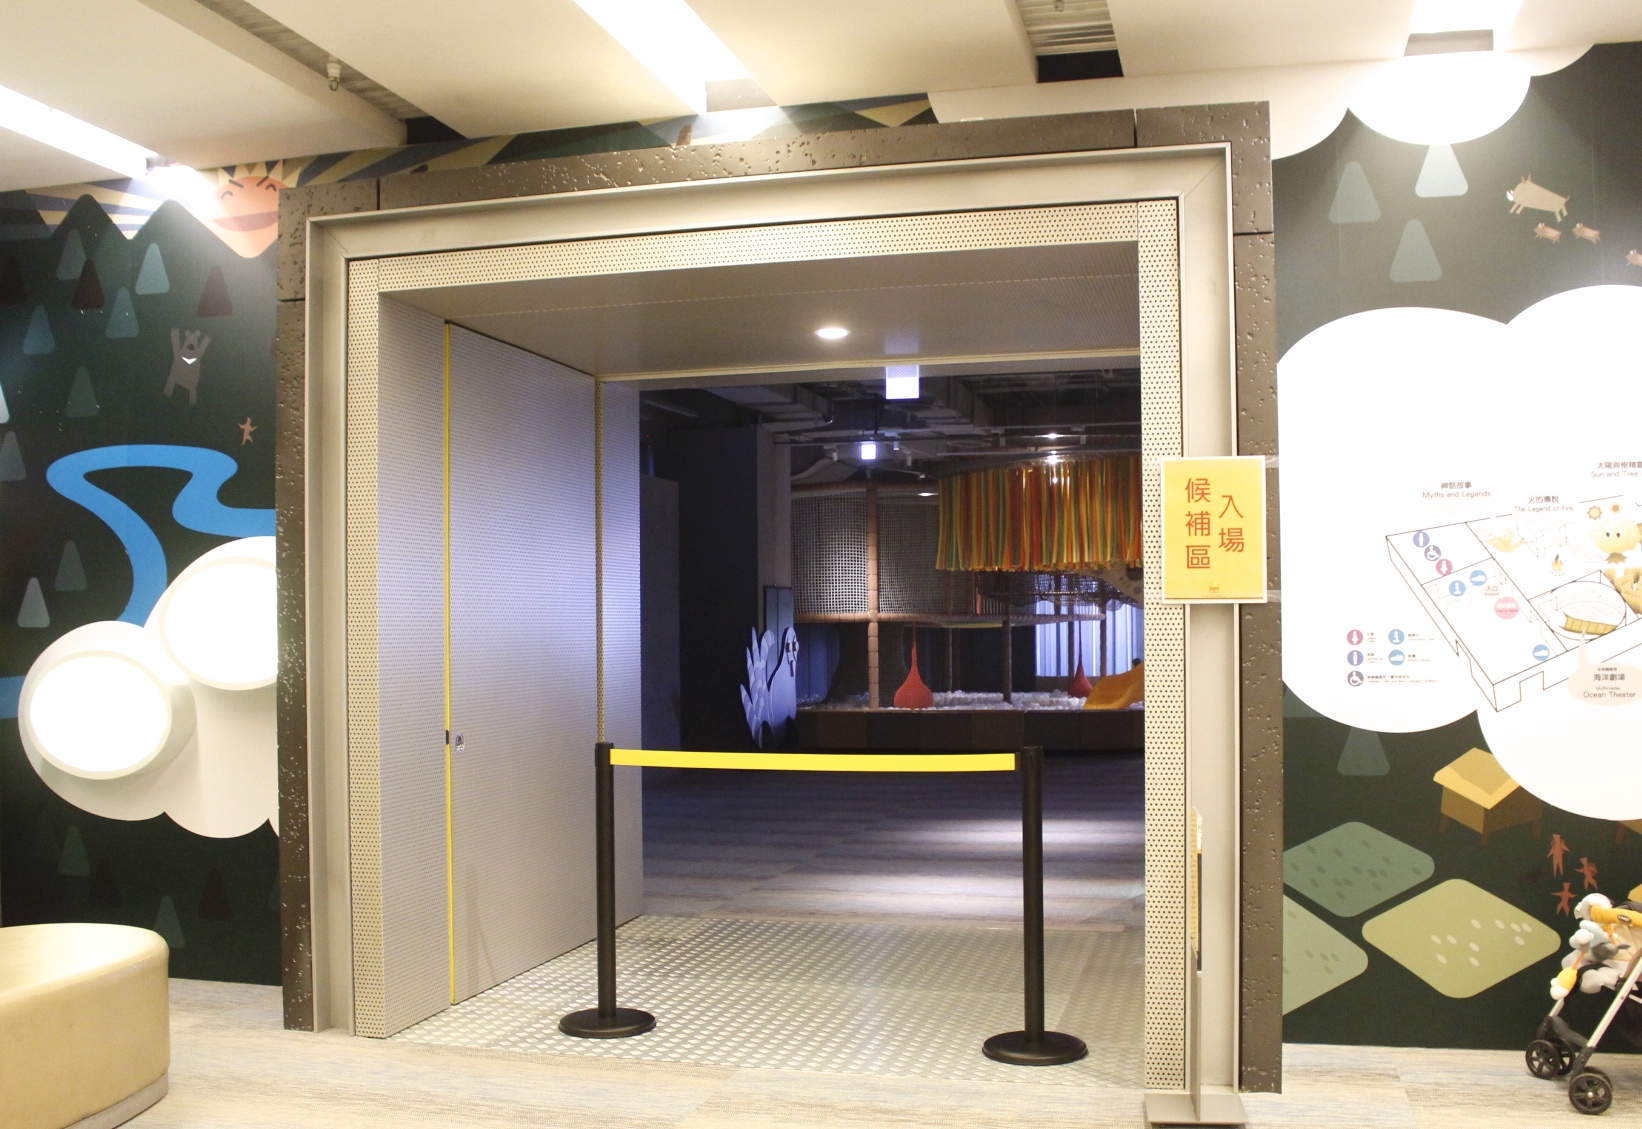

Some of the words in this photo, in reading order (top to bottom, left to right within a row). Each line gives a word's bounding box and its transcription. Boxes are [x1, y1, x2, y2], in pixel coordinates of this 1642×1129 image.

[1591, 470, 1605, 478] Sun
[1607, 470, 1621, 478] and
[1441, 481, 1472, 490] 神話故事
[1422, 491, 1444, 499] Myths
[1462, 490, 1491, 498] Legends
[1528, 505, 1552, 513] Legend
[1185, 477, 1211, 569] 候補區
[1218, 495, 1245, 553] 入場
[1593, 673, 1626, 682] 海洋劇場
[1583, 691, 1606, 699] Ocean
[1609, 690, 1636, 699] Theater
